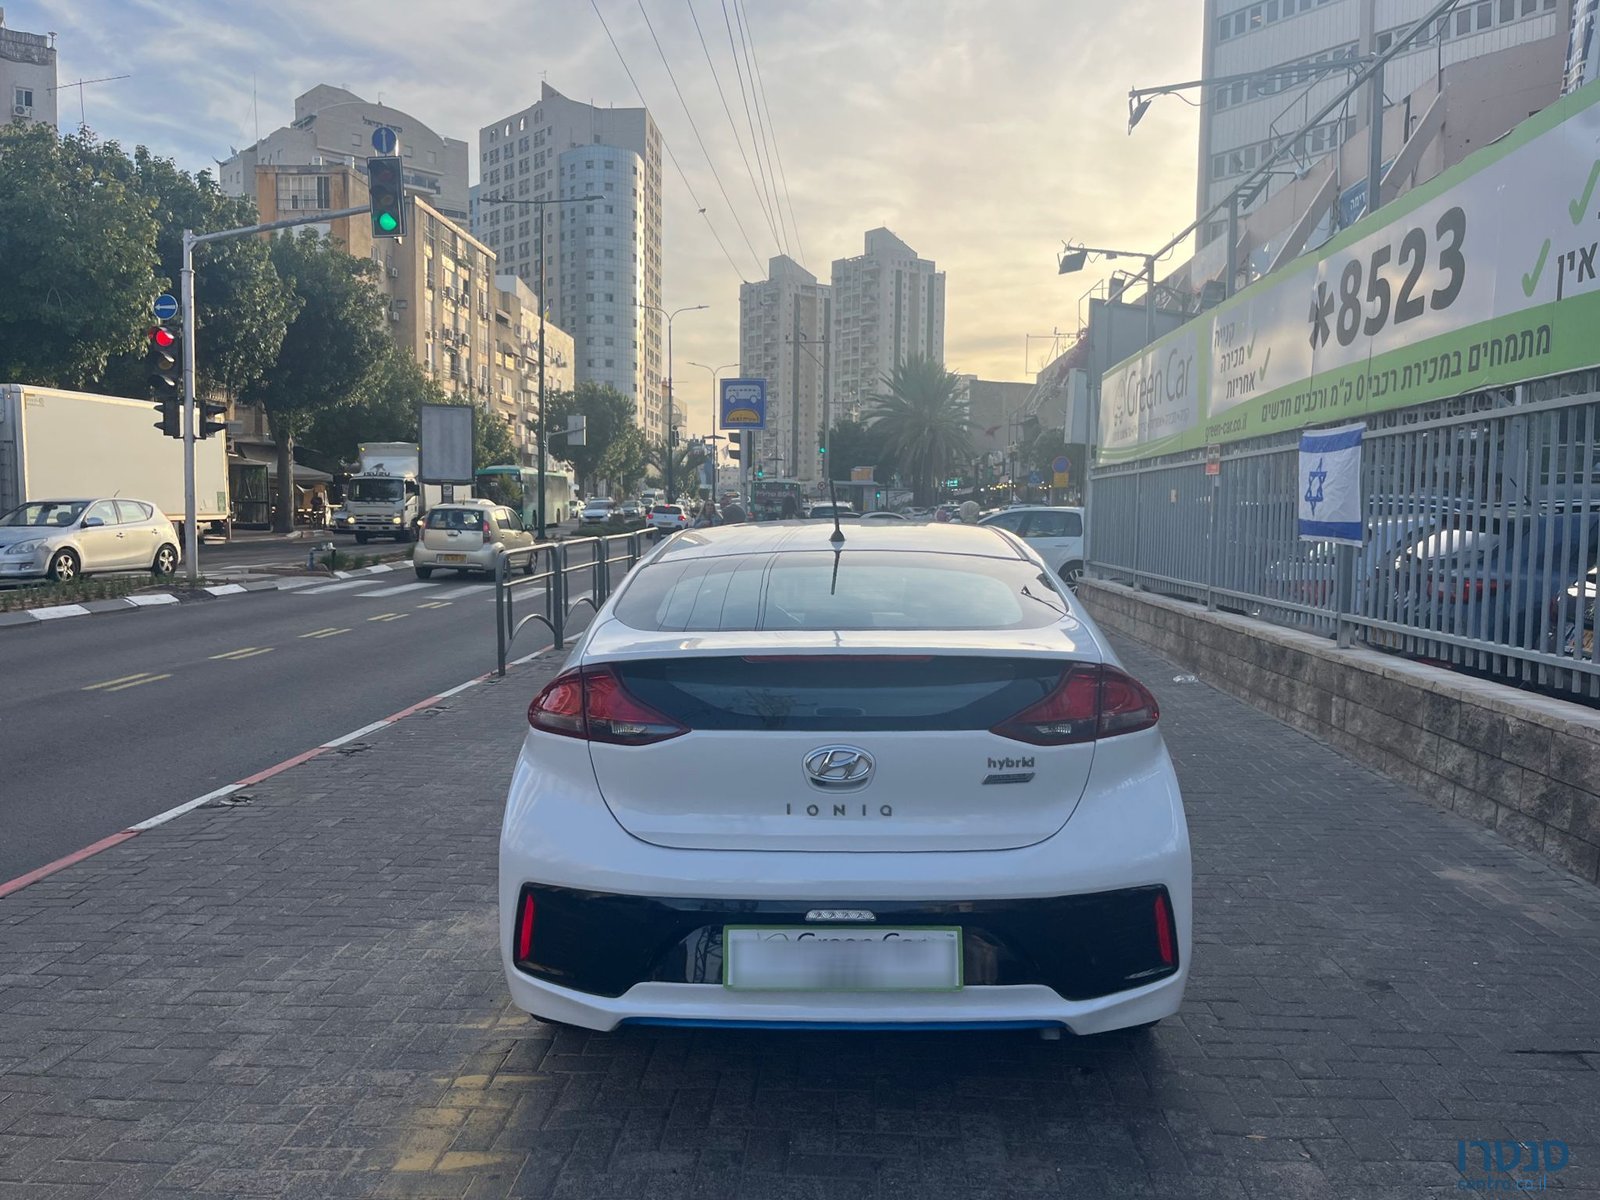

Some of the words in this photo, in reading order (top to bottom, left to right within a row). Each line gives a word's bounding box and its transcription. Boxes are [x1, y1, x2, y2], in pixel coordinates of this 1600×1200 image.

[1556, 242, 1598, 302] אין
[1220, 346, 1245, 373] מכירה
[1468, 324, 1550, 373] מתמחים
[1127, 370, 1163, 418] Green
[1165, 348, 1193, 402] Car
[1400, 350, 1462, 391] במכירת
[1226, 371, 1256, 400] אחריות
[1261, 398, 1292, 423] חדשים
[1294, 387, 1328, 415] ורכבים
[987, 756, 1035, 770] hybrid
[786, 803, 893, 817] IONIQ
